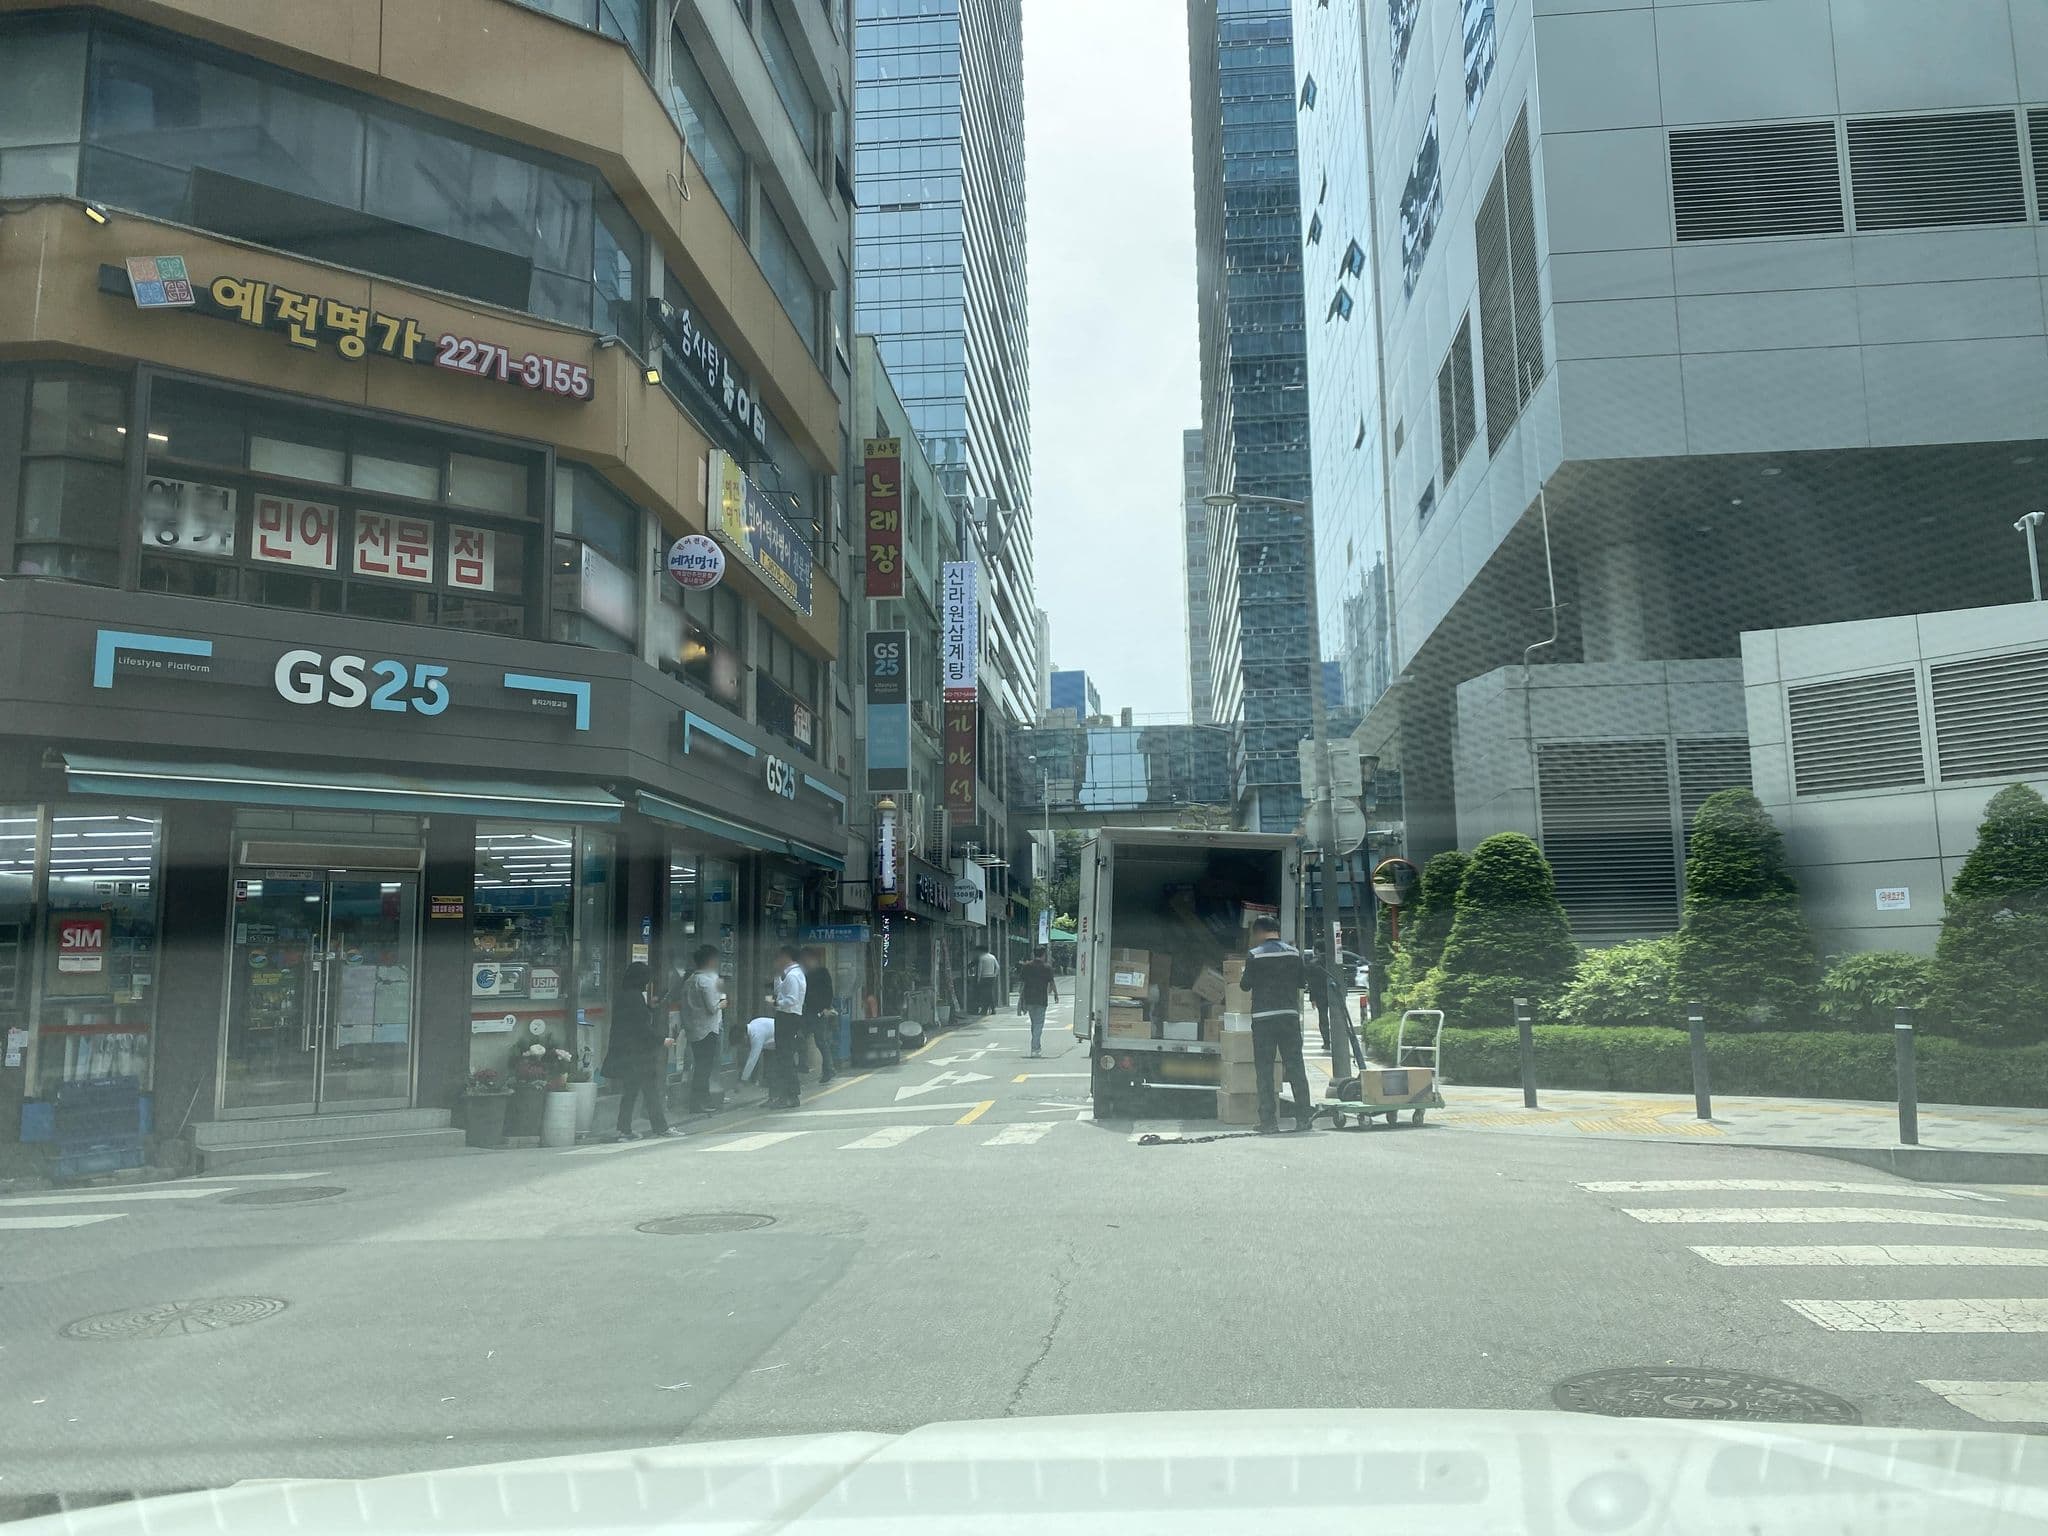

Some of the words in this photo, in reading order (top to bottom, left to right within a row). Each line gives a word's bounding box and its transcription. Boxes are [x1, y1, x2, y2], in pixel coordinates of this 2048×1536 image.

[211, 277, 424, 360] 예전명가
[439, 335, 588, 396] 2271-3155
[870, 474, 898, 574] 노래장
[259, 501, 335, 565] 민어
[359, 514, 429, 578] 전문
[454, 529, 484, 584] 점
[671, 554, 720, 570] 예전명가
[948, 567, 965, 681] 신라원삼계탕
[118, 656, 162, 669] Lifestyle
[167, 661, 210, 673] Platform
[873, 643, 899, 659] GS
[274, 649, 450, 716] GS25
[874, 659, 900, 676] 25
[766, 754, 796, 800] GS25
[62, 928, 102, 947] SIM
[808, 929, 835, 940] ATM
[533, 978, 558, 988] USIM
